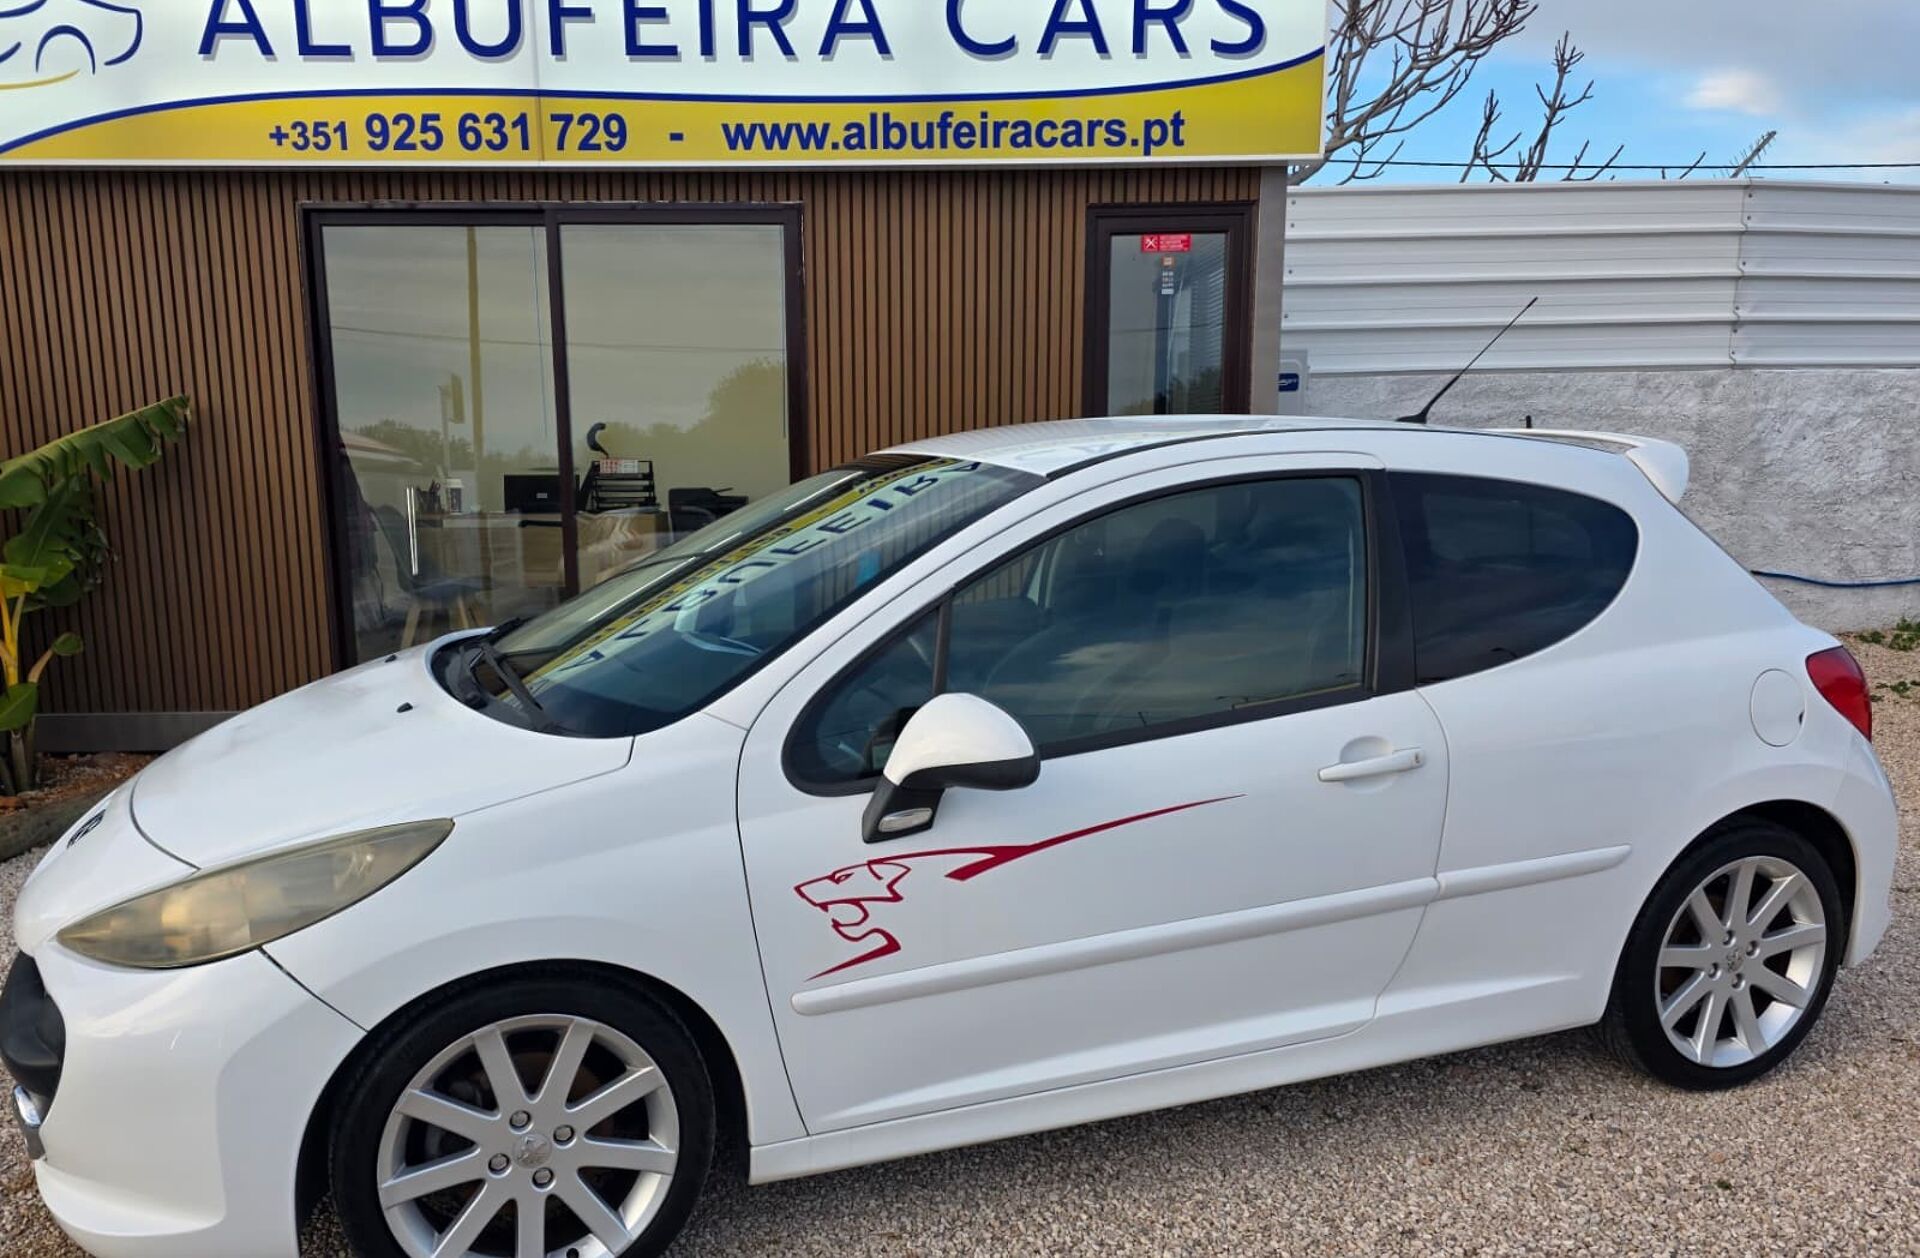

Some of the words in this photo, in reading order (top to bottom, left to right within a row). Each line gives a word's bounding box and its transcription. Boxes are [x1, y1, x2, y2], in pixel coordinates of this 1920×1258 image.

[199, 0, 891, 58] ALBUFEIRA
[946, 0, 1266, 57] CARS
[269, 122, 348, 151] +351
[366, 113, 444, 151] 925
[457, 113, 530, 151] 631
[551, 113, 627, 152] 729
[721, 111, 1185, 157] www.albufeiracars.pt
